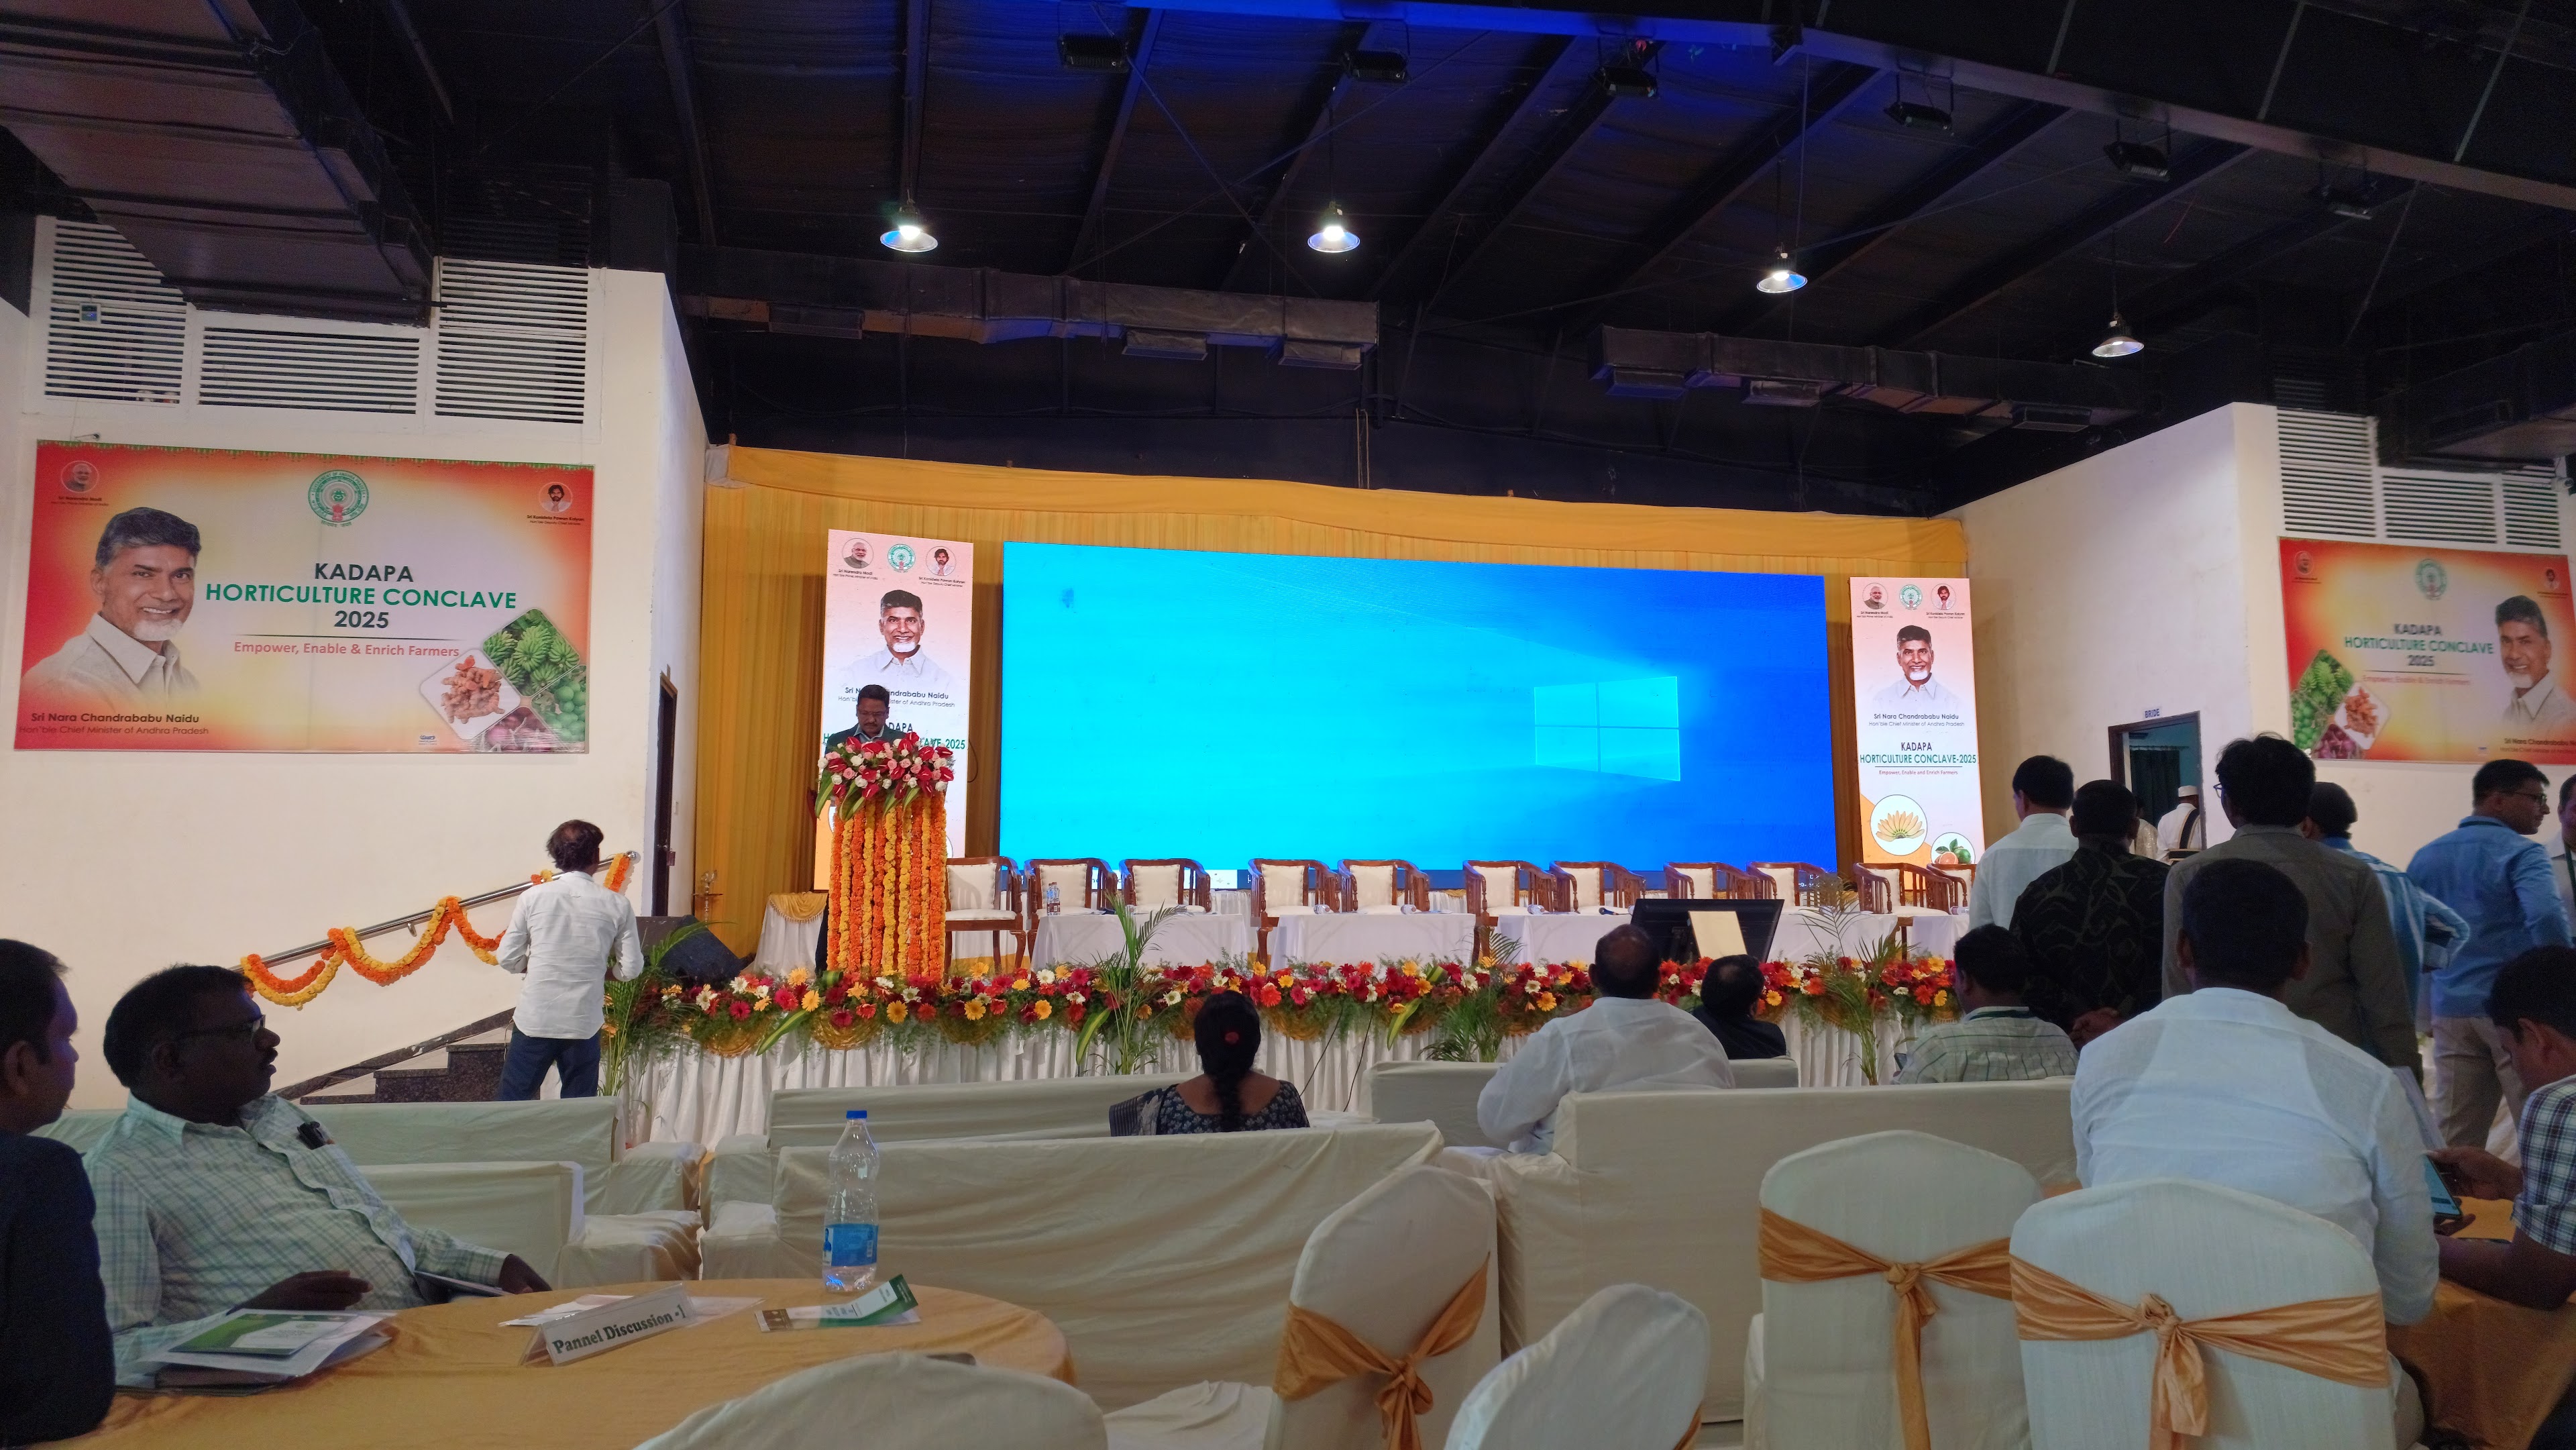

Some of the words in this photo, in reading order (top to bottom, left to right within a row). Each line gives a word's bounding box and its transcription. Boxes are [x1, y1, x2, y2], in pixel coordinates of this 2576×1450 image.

[314, 562, 415, 583] KADAPA
[205, 583, 376, 605] HORTICULTURE
[383, 587, 517, 609] CONCLAVE
[333, 610, 389, 629] 2025
[2394, 623, 2443, 636] KADAPA
[233, 641, 300, 656] Empower,
[303, 642, 347, 655] Enable
[350, 643, 361, 655] &
[365, 643, 406, 656] Enrich
[409, 645, 460, 657] Farmers
[2345, 636, 2426, 652] HORTICULTURE
[2428, 639, 2494, 654] CONCLAVE
[2407, 654, 2436, 667] 2025
[928, 692, 949, 700] Naidu
[31, 713, 45, 722] Sri
[48, 713, 77, 722] Nara
[80, 713, 162, 723] Chandrababu
[166, 714, 199, 723] Naidu
[2145, 708, 2160, 719] BRIDE
[59, 725, 86, 734] Chief
[87, 726, 122, 734] Minister
[125, 726, 135, 734] of
[136, 726, 170, 735] Andhra
[172, 727, 209, 735] Pradesh
[888, 722, 913, 733] DAPA
[1900, 741, 1933, 751] KADAPA
[1860, 754, 1912, 764] HORTICULTURE
[1914, 754, 1976, 764] CONCLAVE-2025
[551, 1329, 604, 1354] Pannel
[603, 1312, 674, 1341] Discussion
